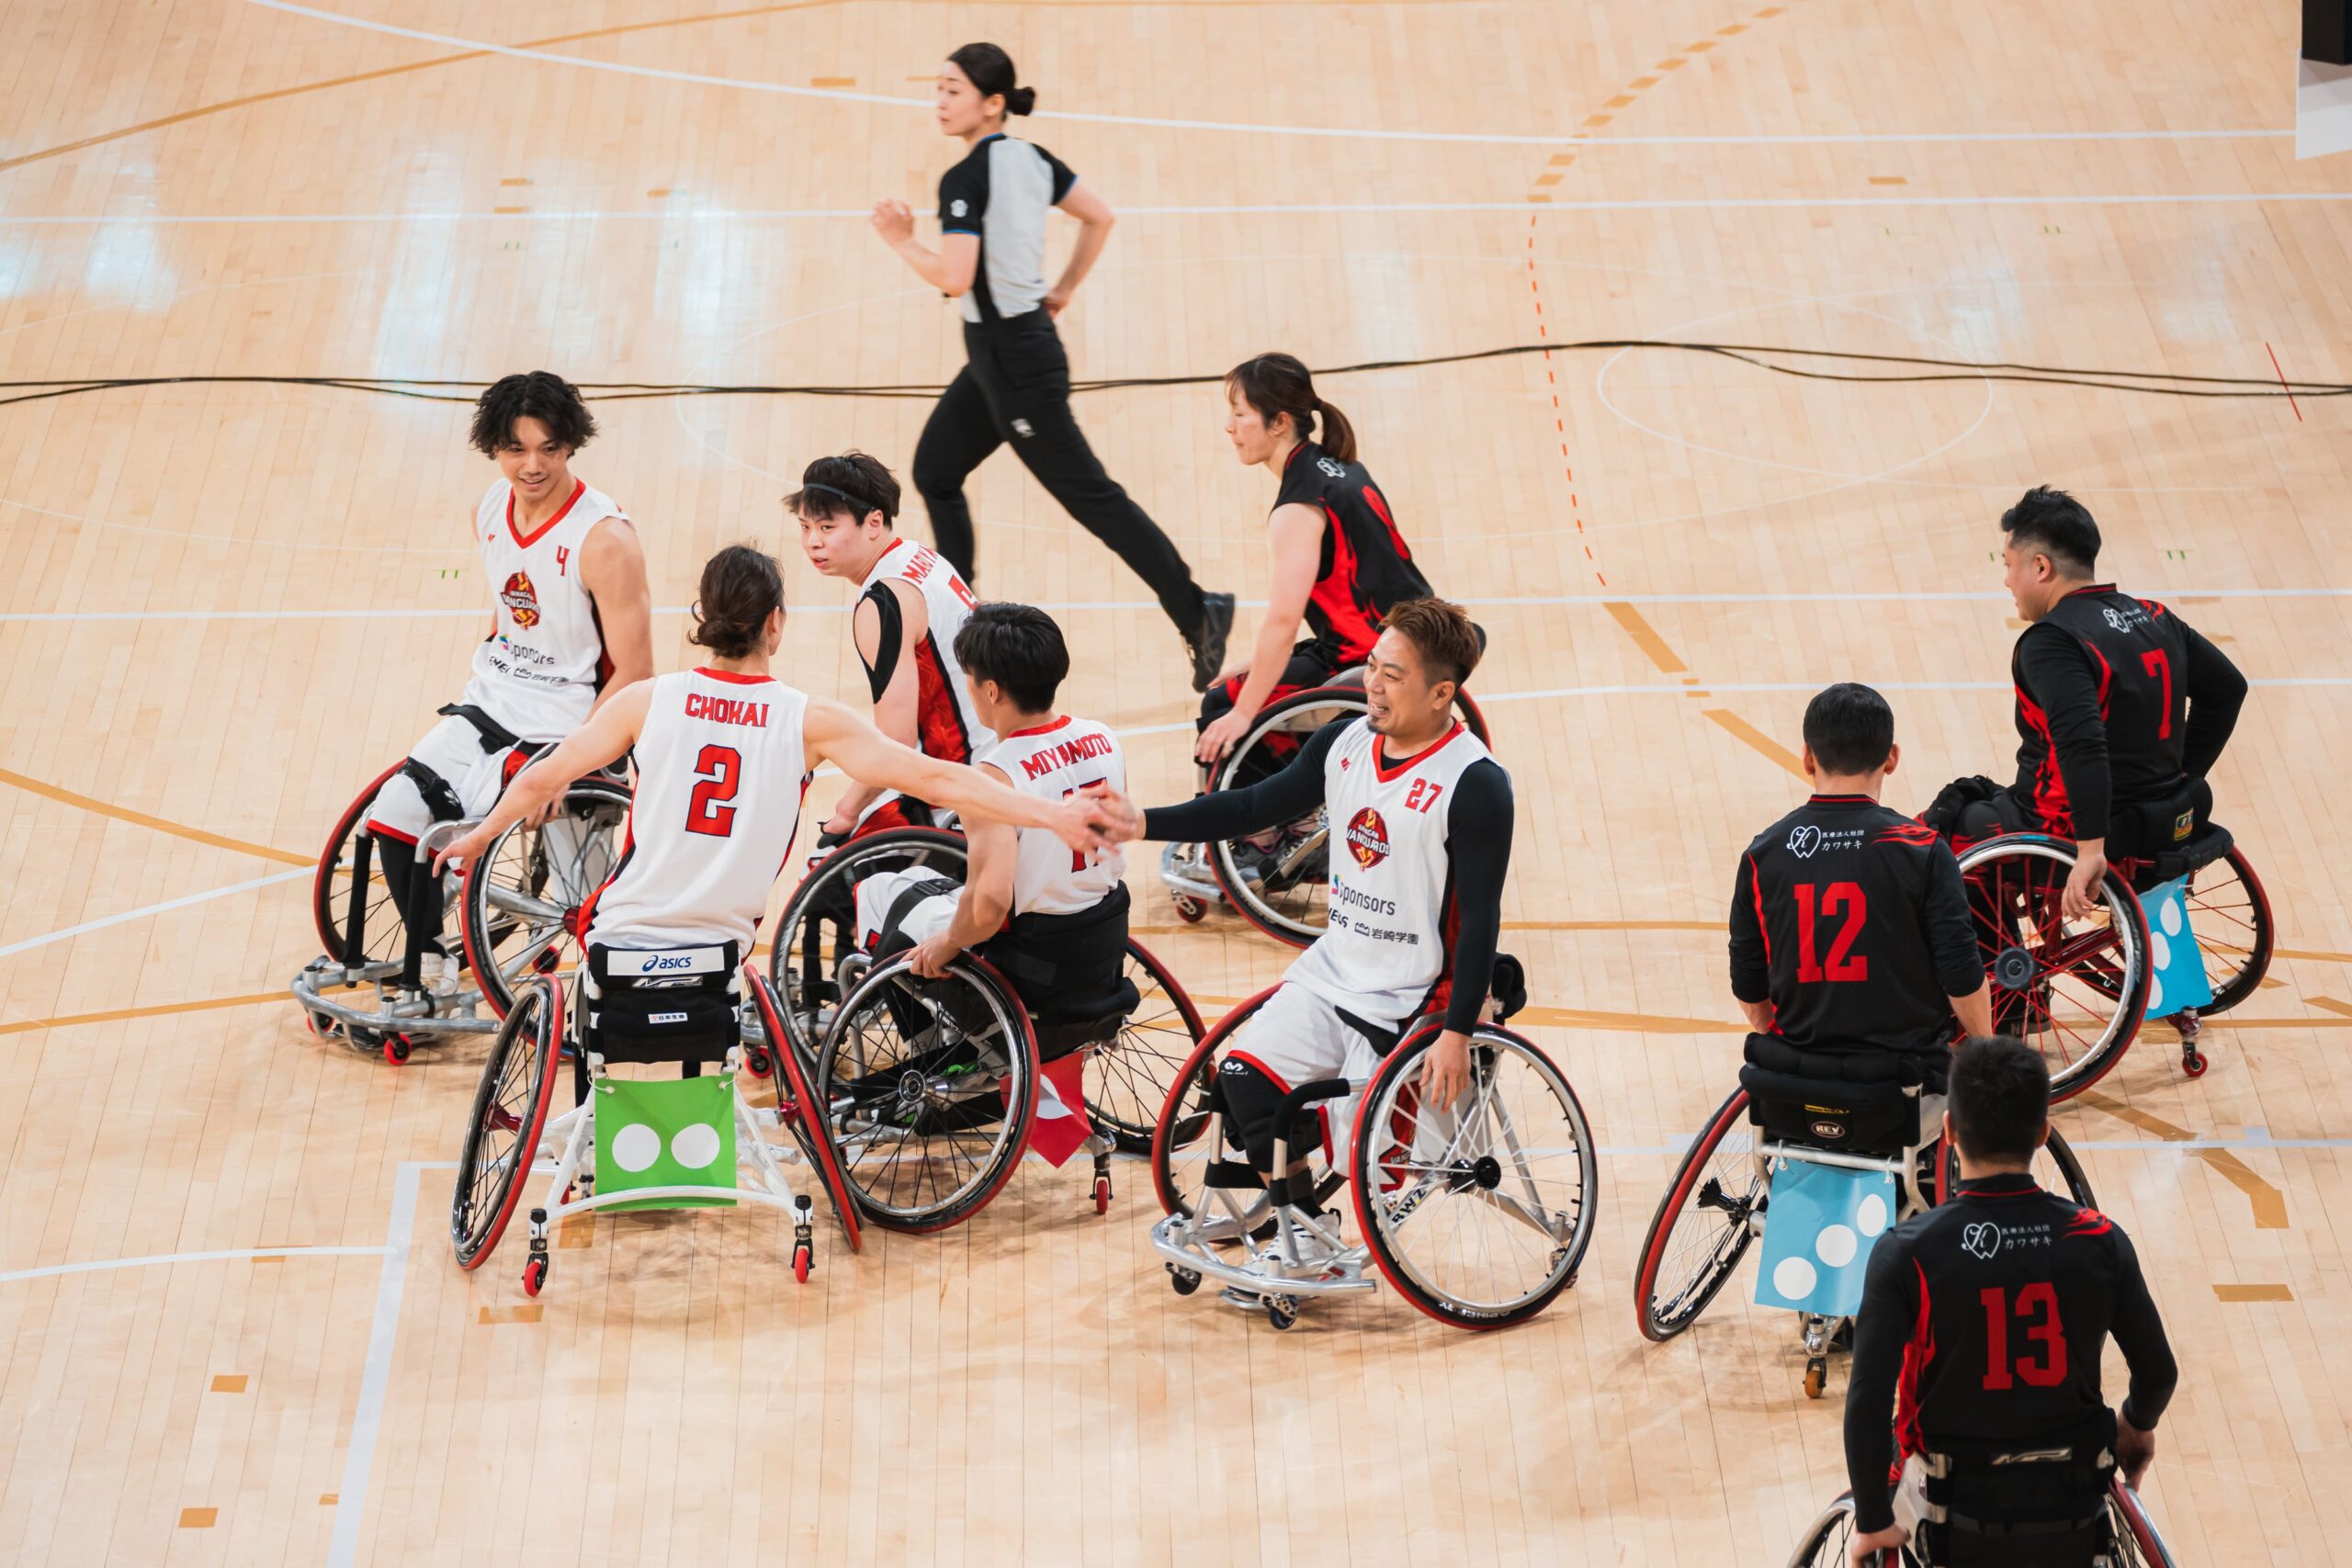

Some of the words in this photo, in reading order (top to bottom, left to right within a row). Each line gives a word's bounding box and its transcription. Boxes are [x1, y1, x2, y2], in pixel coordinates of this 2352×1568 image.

[555, 545, 570, 576] 4
[684, 694, 770, 728] CHOKAI
[2140, 648, 2172, 740] 7
[1019, 733, 1113, 781] MIYAMOTO
[685, 743, 741, 838] 2
[1405, 777, 1442, 814] 27
[1822, 840, 1862, 852] カワサキ
[1793, 882, 1868, 983] 12
[2005, 1235, 2052, 1250] カワサキ
[1980, 1281, 2067, 1390] 13
